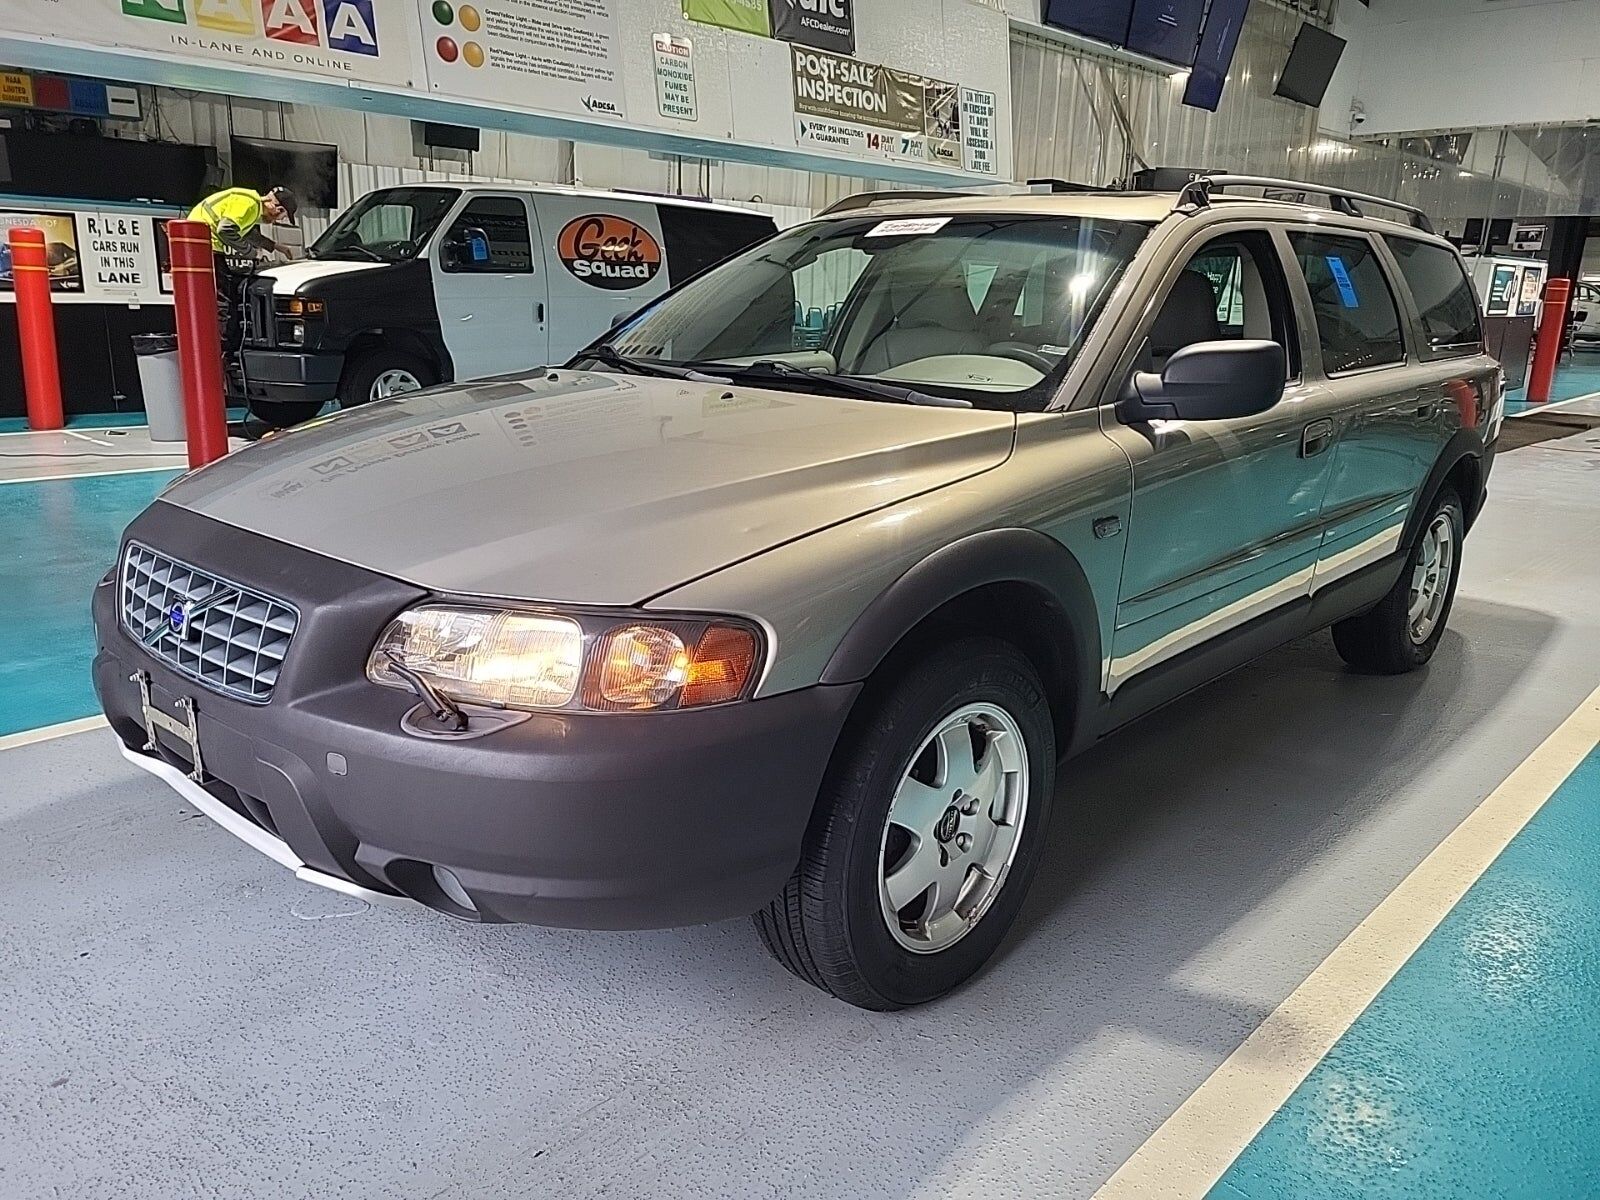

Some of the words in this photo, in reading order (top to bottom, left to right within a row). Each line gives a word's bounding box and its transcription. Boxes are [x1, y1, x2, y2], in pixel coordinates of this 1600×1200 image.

[171, 35, 244, 54] IN-LANE
[252, 48, 285, 60] AND
[293, 54, 352, 71] ONLINE
[657, 43, 689, 56] CAUTION
[660, 57, 688, 69] CARBON
[796, 51, 874, 87] POST-SALE
[657, 68, 693, 81] MONOXIDE
[664, 81, 687, 92] FUMES
[665, 92, 679, 102] MAY
[681, 95, 689, 103] BE
[797, 76, 887, 113] INSPECTION
[663, 104, 693, 116] PRESENT
[809, 122, 827, 132] EVERY
[828, 125, 837, 134] PSI
[838, 126, 864, 138] INCLUDES
[866, 133, 880, 150] 14
[881, 135, 894, 145] DAY
[901, 139, 910, 154] 7
[910, 140, 923, 149] DAY
[815, 134, 849, 146] GUARANTEE
[880, 143, 895, 153] FULL
[910, 147, 923, 158] FULL
[971, 160, 981, 170] LATE
[982, 161, 990, 171] FEE
[105, 219, 113, 234] L
[118, 220, 127, 235] &
[132, 221, 140, 236] E
[573, 218, 644, 261] Geek
[92, 241, 117, 252] CARS
[120, 242, 139, 253] RUN
[100, 256, 110, 268] IN
[113, 257, 135, 268] THIS
[573, 260, 650, 278] Squad
[98, 272, 141, 284] LANE
